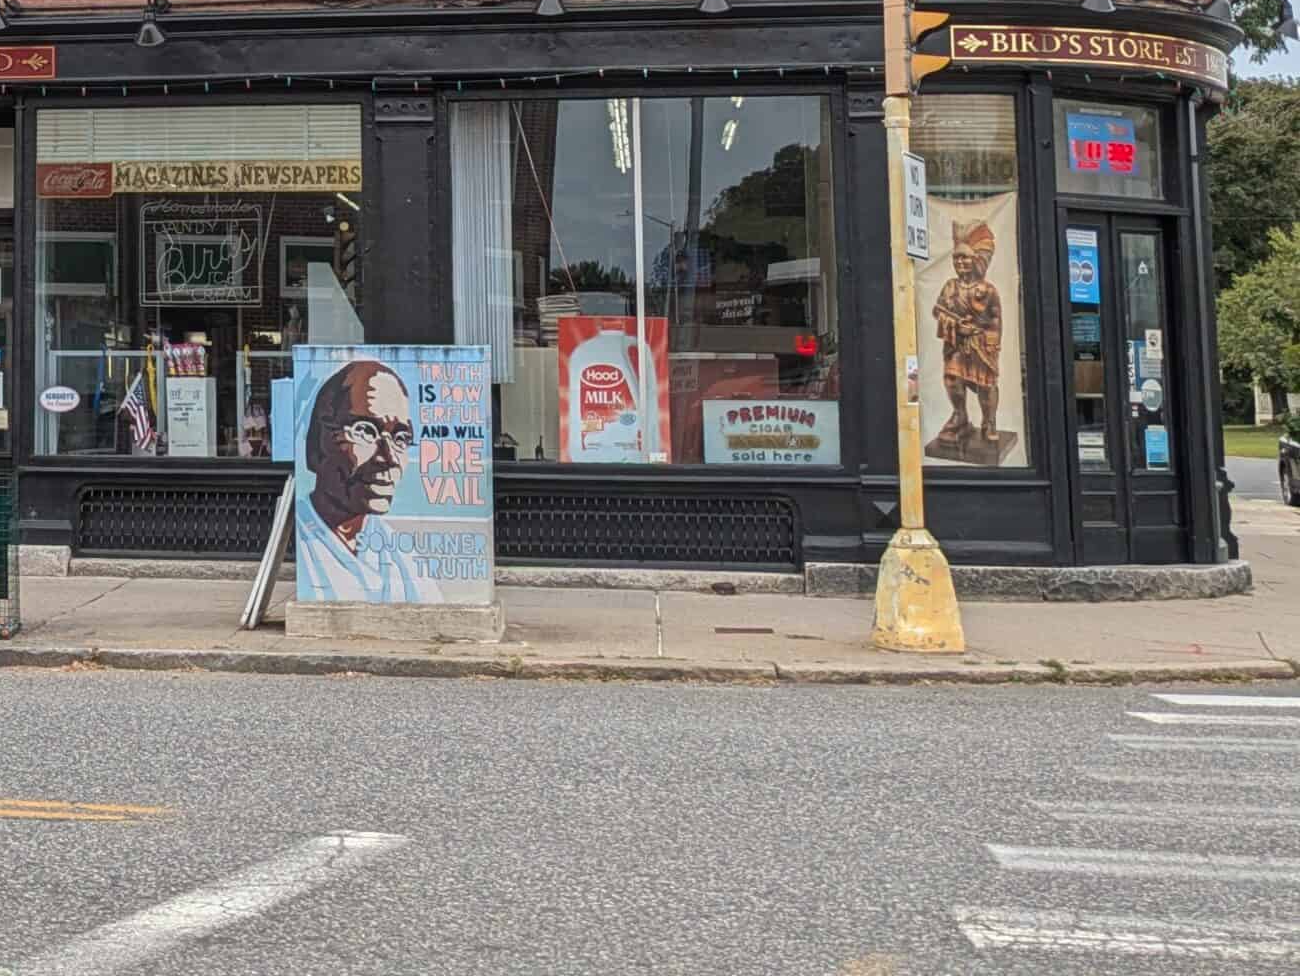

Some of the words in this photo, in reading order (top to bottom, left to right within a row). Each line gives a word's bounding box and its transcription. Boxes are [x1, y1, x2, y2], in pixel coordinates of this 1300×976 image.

[990, 32, 1083, 55] BIRD'S
[115, 163, 229, 188] MAGAZINES
[238, 164, 362, 186] NEWSPAPERS
[910, 164, 920, 187] NO
[419, 362, 484, 384] TRUTH
[585, 368, 620, 382] Hood
[418, 384, 437, 404] IS
[440, 384, 484, 403] POW
[584, 390, 623, 404] MILK
[419, 404, 485, 425] ERFUL
[726, 404, 817, 429] PREMIUM
[420, 425, 451, 439] AND
[454, 425, 485, 439] WILL
[749, 423, 793, 433] CIGAR
[419, 440, 485, 474] PRE
[731, 450, 766, 462] sold
[772, 451, 813, 463] here
[420, 474, 486, 505] VAIL
[355, 530, 487, 556] SOJOURNER
[413, 555, 489, 580] TRUTH
